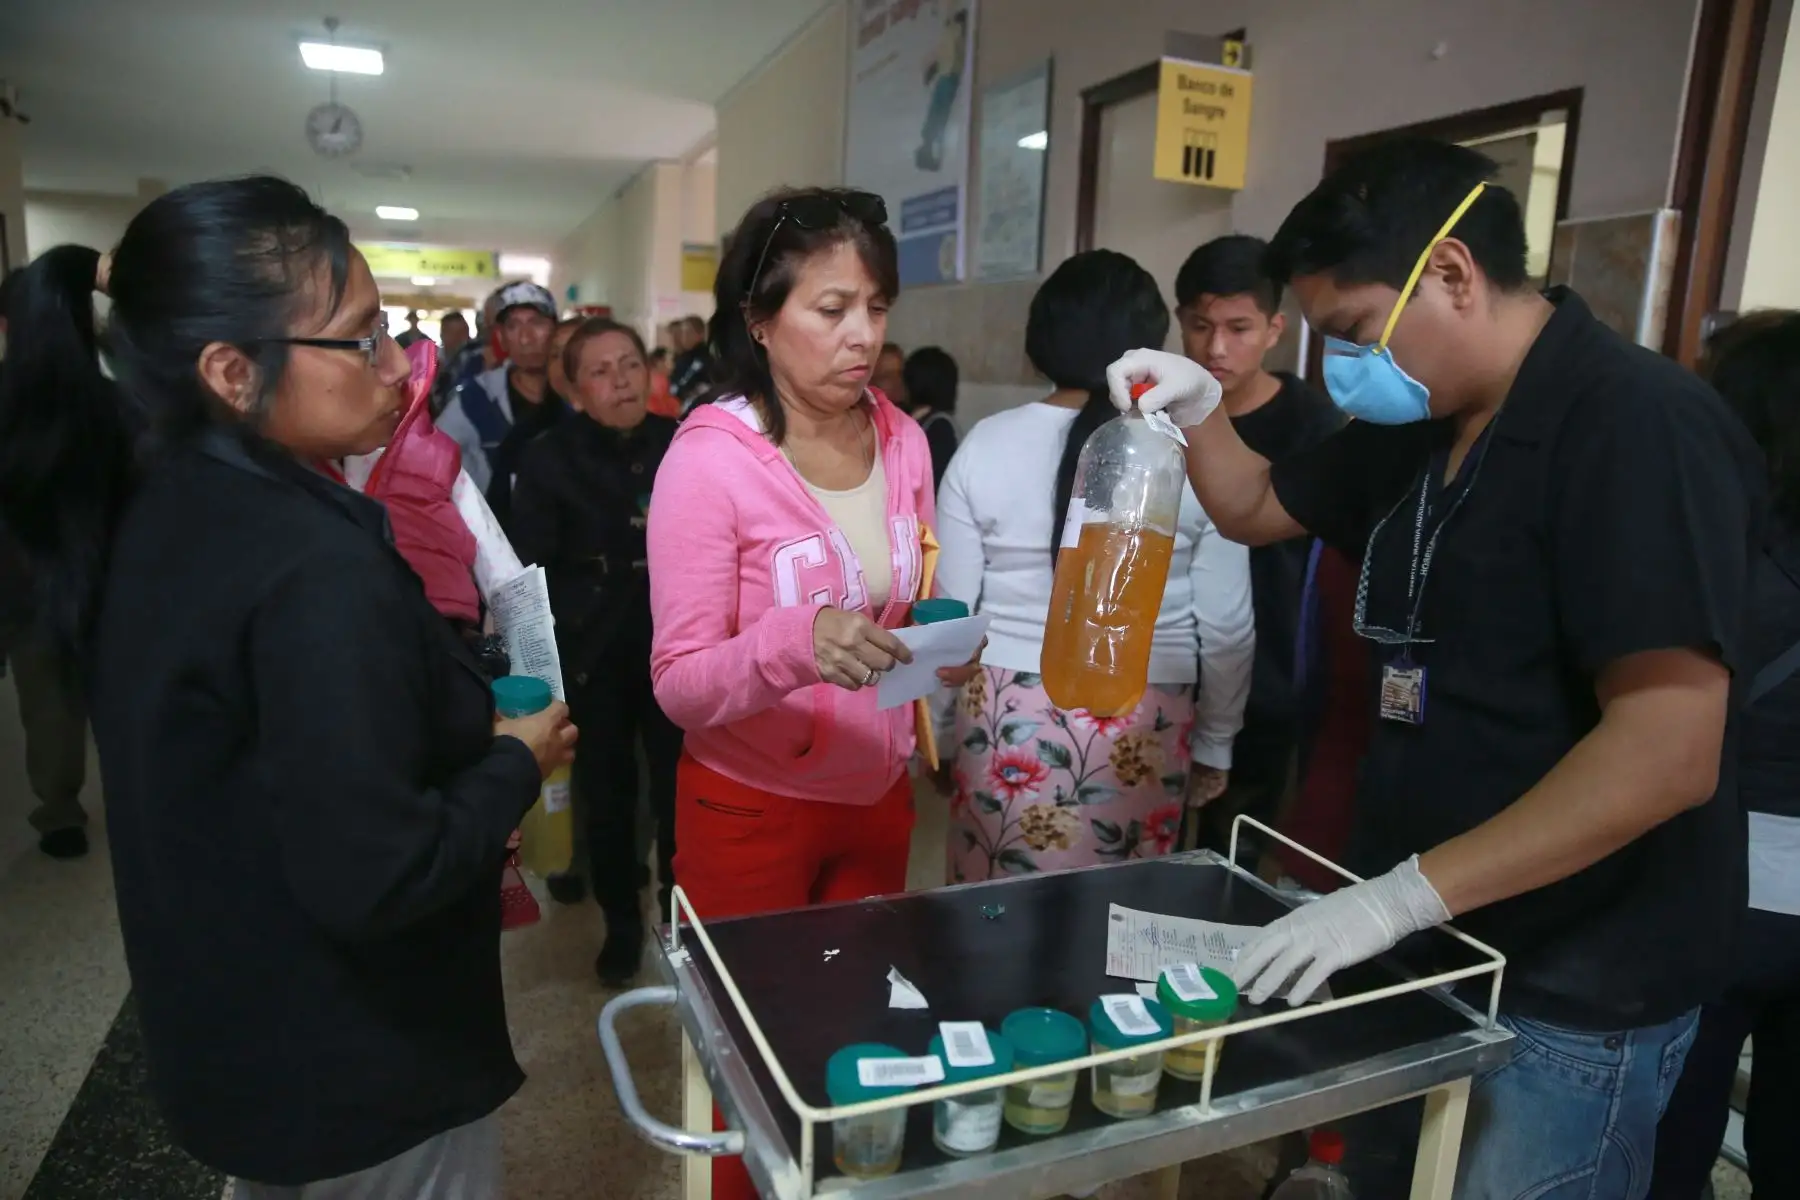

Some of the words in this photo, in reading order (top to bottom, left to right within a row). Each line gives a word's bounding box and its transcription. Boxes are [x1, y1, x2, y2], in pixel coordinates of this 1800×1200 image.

[1177, 74, 1216, 95] Banco
[1220, 83, 1235, 97] de
[1183, 97, 1227, 121] Sangre
